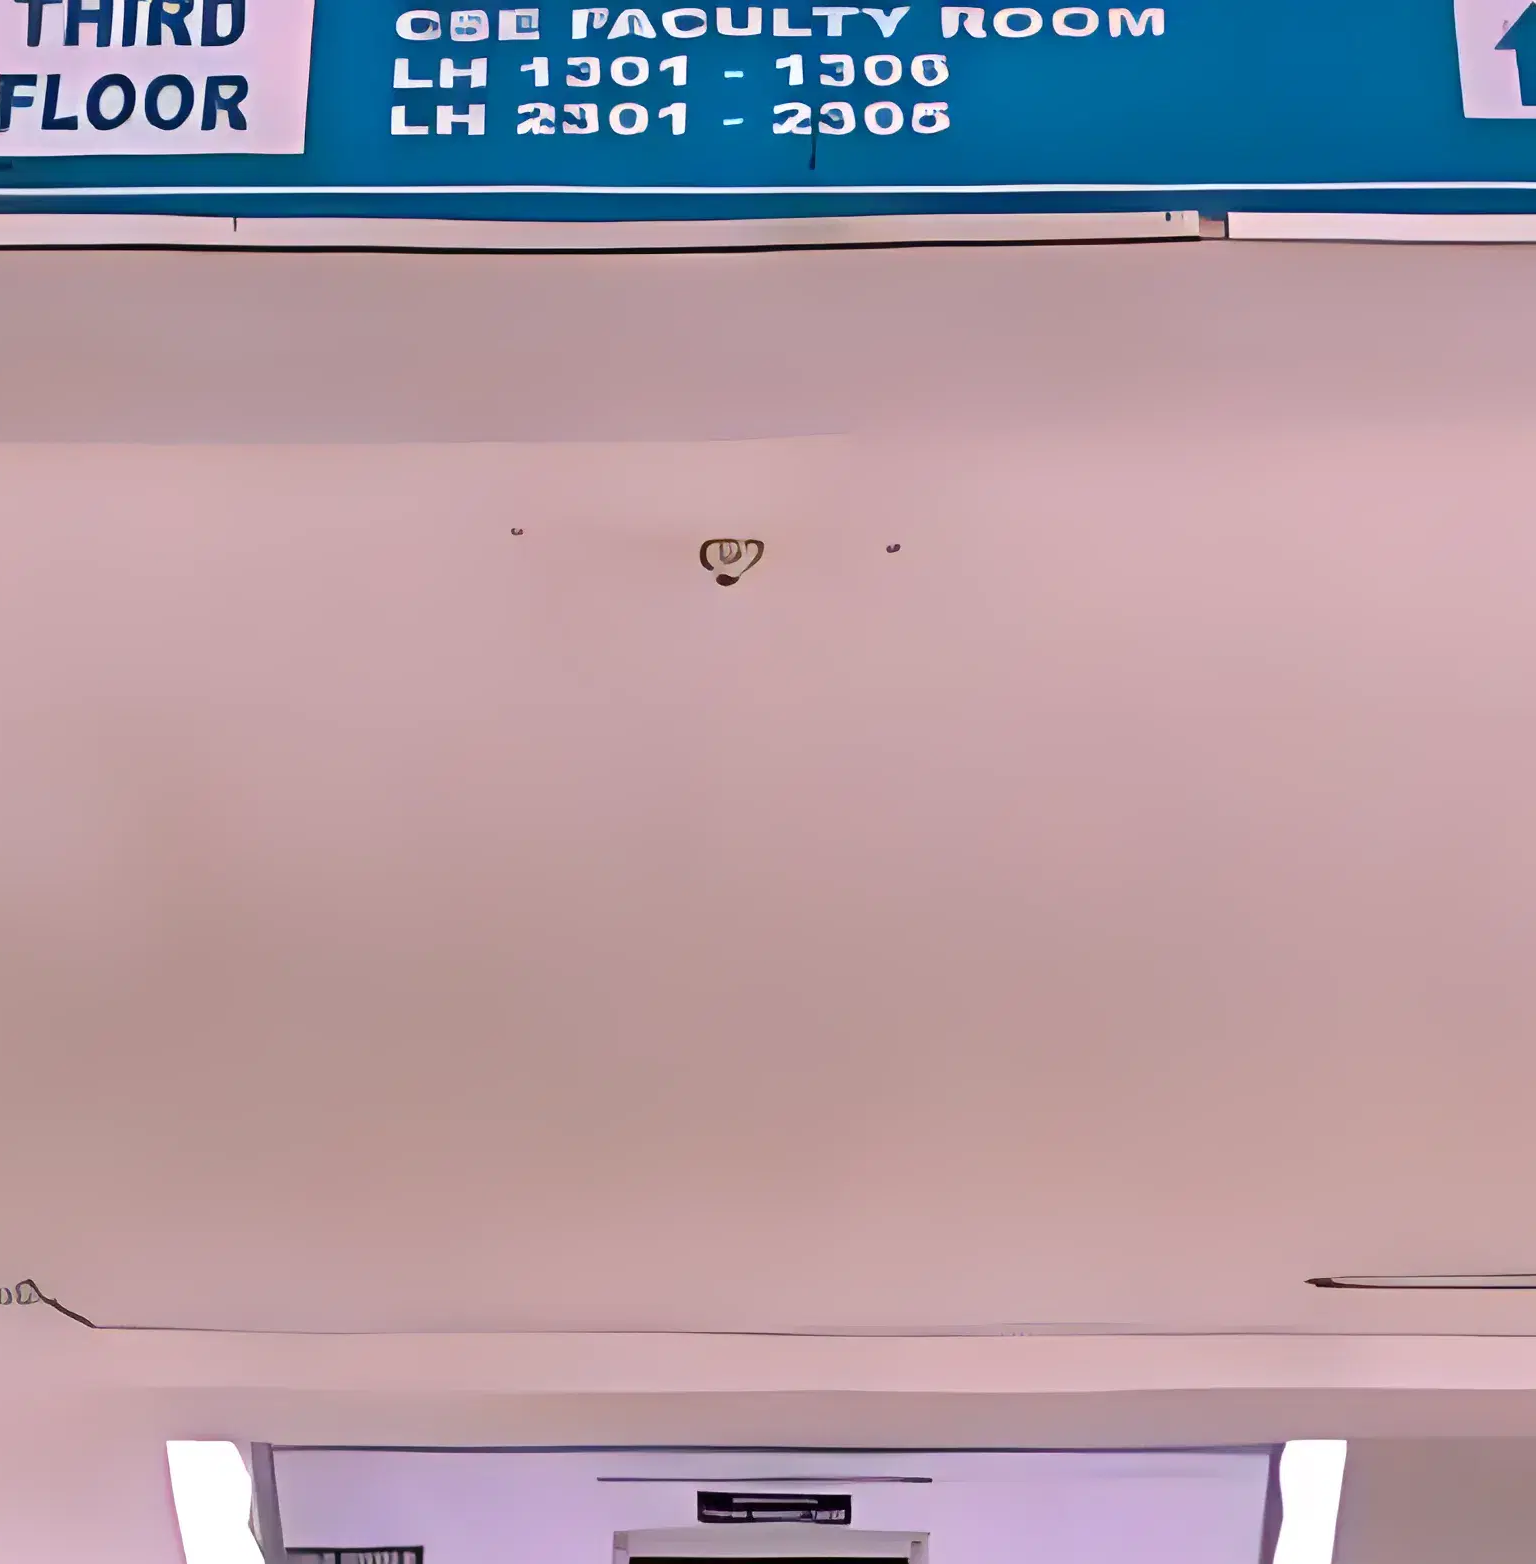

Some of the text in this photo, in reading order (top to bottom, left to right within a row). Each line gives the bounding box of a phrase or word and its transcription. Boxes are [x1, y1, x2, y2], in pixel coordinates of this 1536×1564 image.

[13, 0, 247, 48] THIRD
[571, 6, 911, 40] FACULTY
[941, 6, 1165, 39] ROOM
[392, 57, 488, 89] LH
[390, 103, 486, 136] LH
